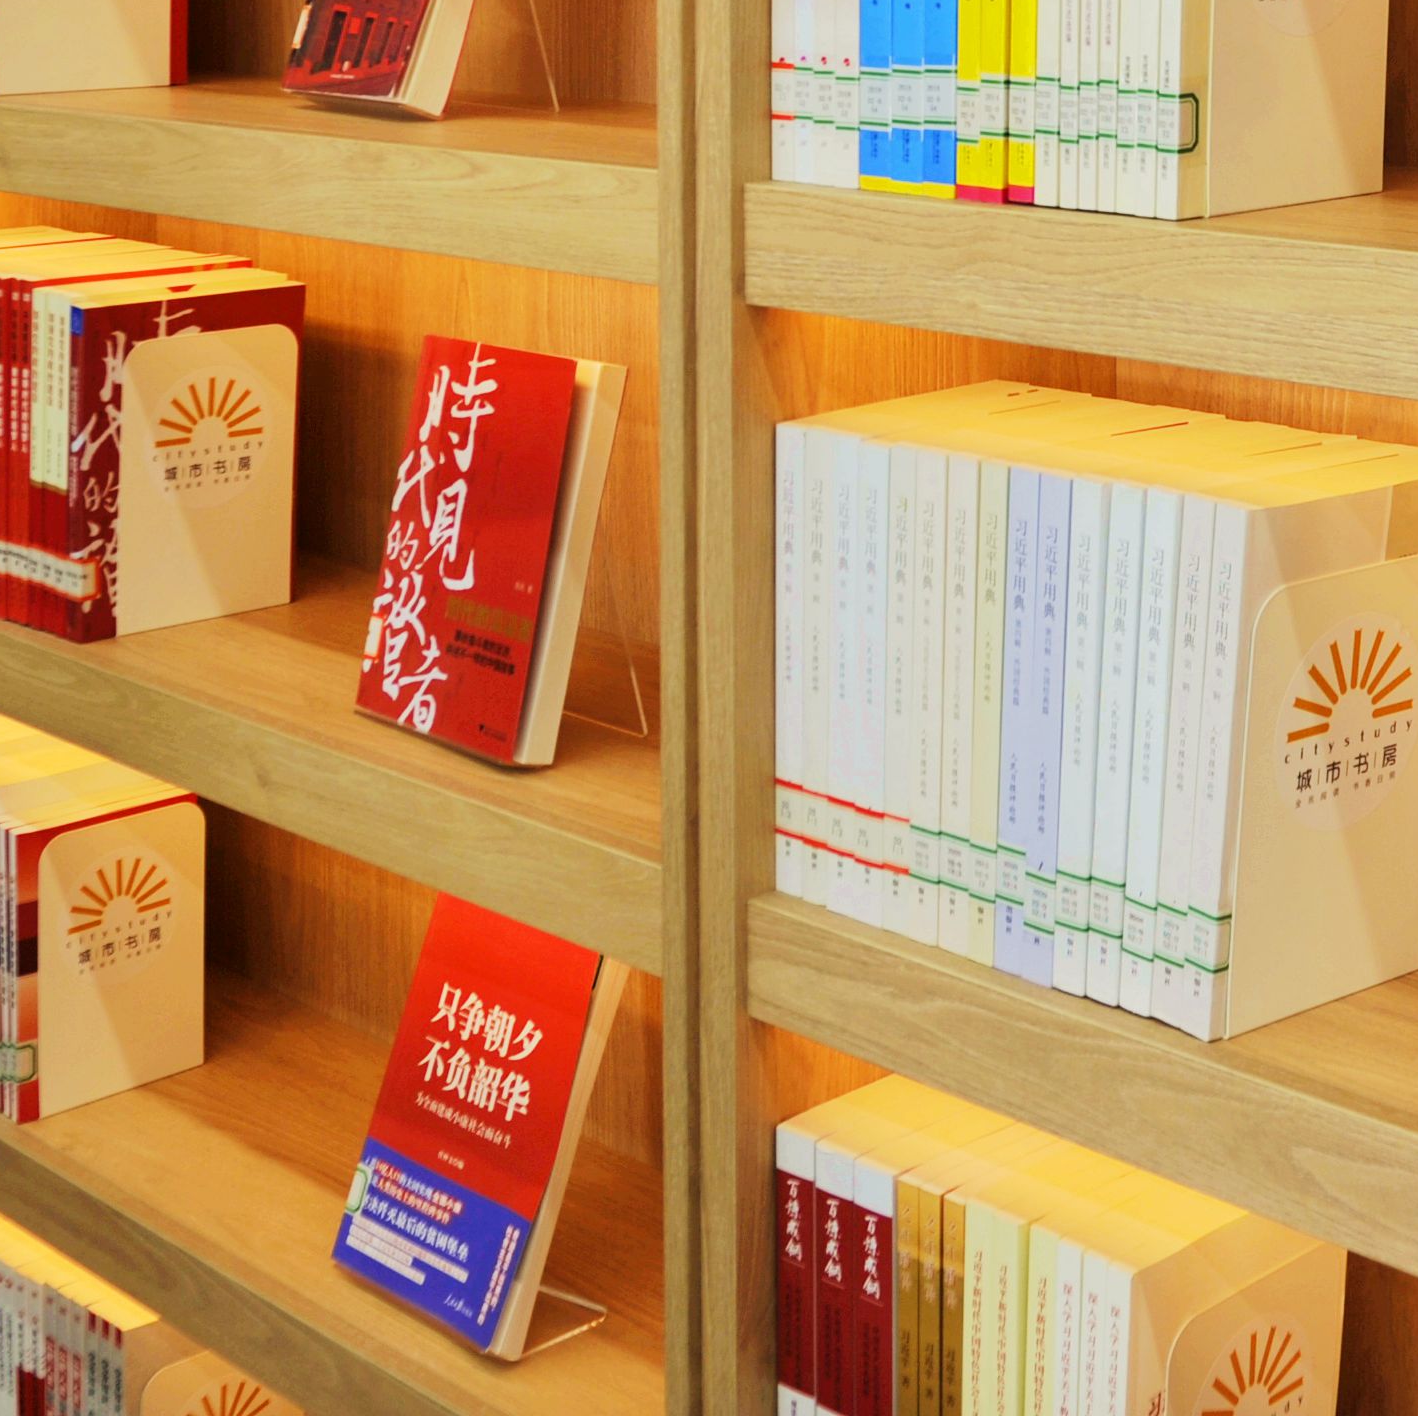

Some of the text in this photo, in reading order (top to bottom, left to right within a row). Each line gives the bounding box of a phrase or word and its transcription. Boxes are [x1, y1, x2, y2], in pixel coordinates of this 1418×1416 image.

[1012, 519, 1028, 614] 习近平用典
[1043, 526, 1059, 623] 习近平用典
[1075, 535, 1092, 632] 习近平用典
[1112, 539, 1131, 638] 习近平用典
[1146, 548, 1165, 647] 习近平用典
[1182, 553, 1202, 652] 习近平用典
[1213, 561, 1233, 662] 习近平用典
[1283, 717, 1414, 766] citystudy
[1294, 742, 1399, 795] 城市书房
[430, 980, 544, 1063] 只争朝夕
[417, 1033, 532, 1122] 不负韶华
